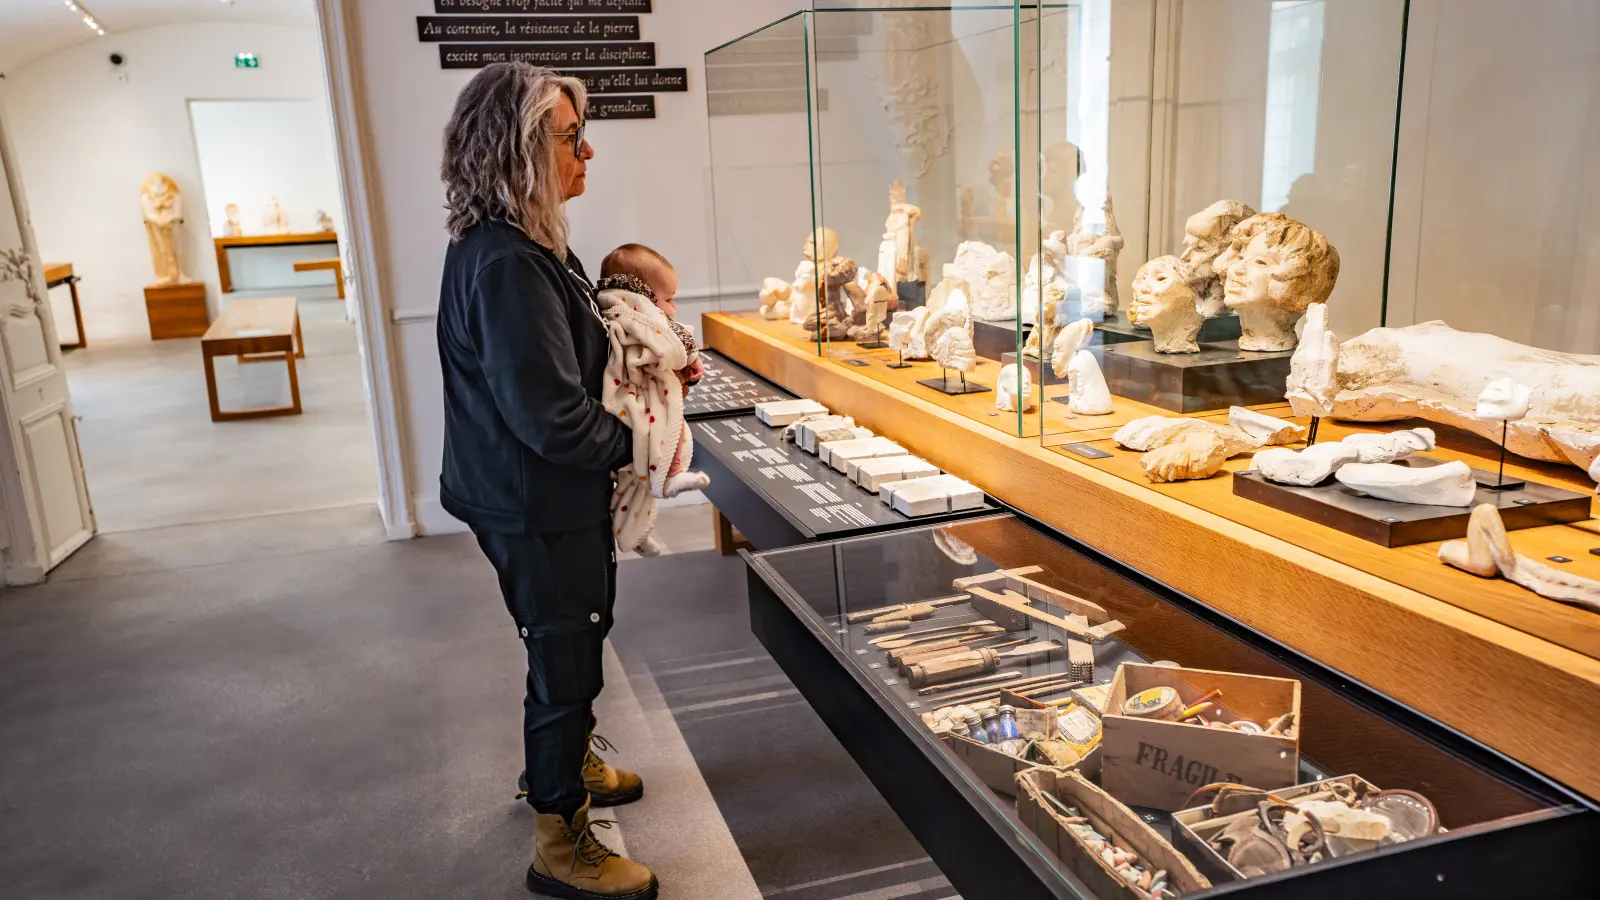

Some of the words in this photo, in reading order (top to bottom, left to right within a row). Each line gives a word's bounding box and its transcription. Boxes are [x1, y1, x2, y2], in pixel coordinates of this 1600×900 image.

[423, 22, 442, 34] Au
[446, 22, 500, 36] contraire,
[505, 21, 516, 34] la
[520, 21, 569, 34] résistance
[573, 21, 586, 34] de
[589, 20, 599, 34] la
[604, 23, 634, 37] pierre
[446, 50, 478, 61] excite
[482, 52, 505, 61] mon
[510, 50, 568, 63] inspiration
[571, 51, 582, 60] et
[585, 47, 595, 60] la
[600, 47, 650, 63] discipline.
[598, 73, 631, 90] qu'elle
[635, 73, 648, 85] lui
[652, 73, 682, 85] donne
[600, 99, 650, 117] grandeur.
